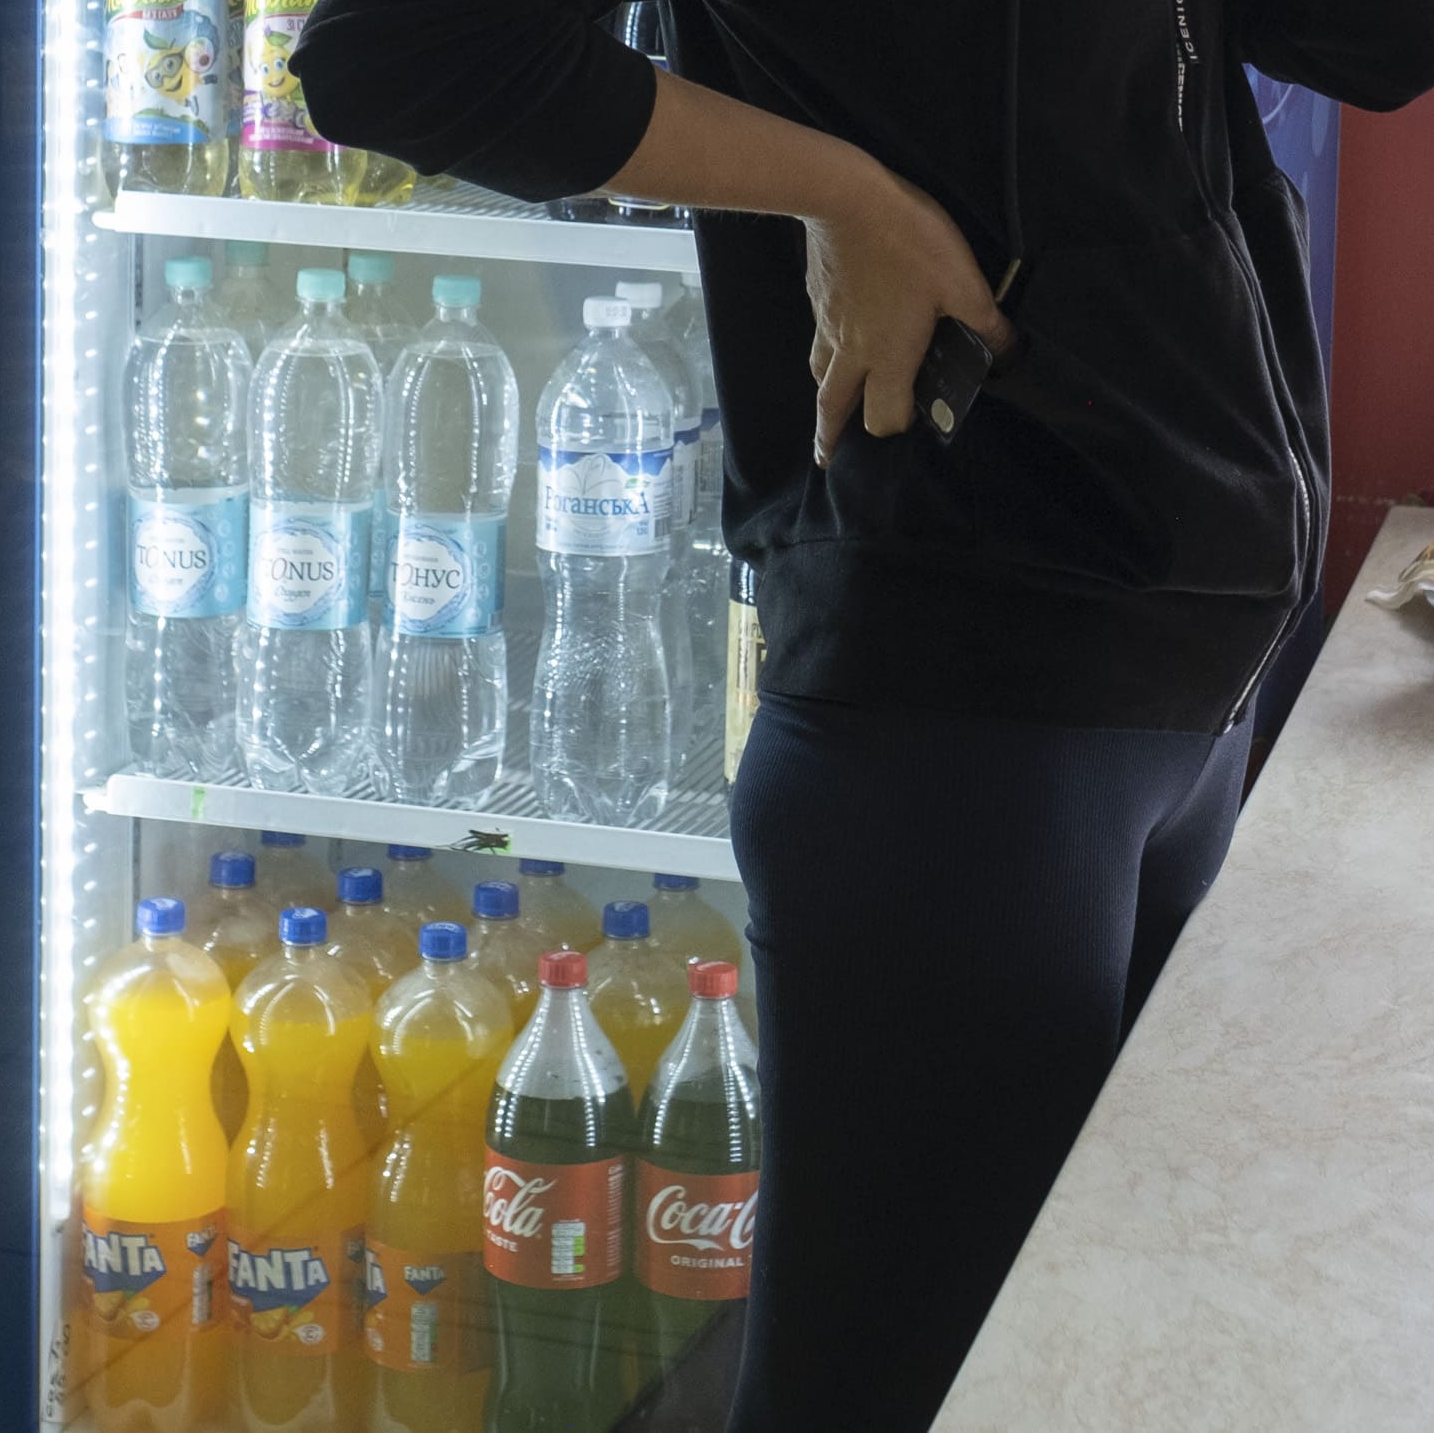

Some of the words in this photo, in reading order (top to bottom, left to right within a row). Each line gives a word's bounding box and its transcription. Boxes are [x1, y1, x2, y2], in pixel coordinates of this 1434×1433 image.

[83, 1226, 165, 1276] ANTA
[227, 1239, 330, 1292] FANTA
[670, 1255, 744, 1269] ORIGINAL
